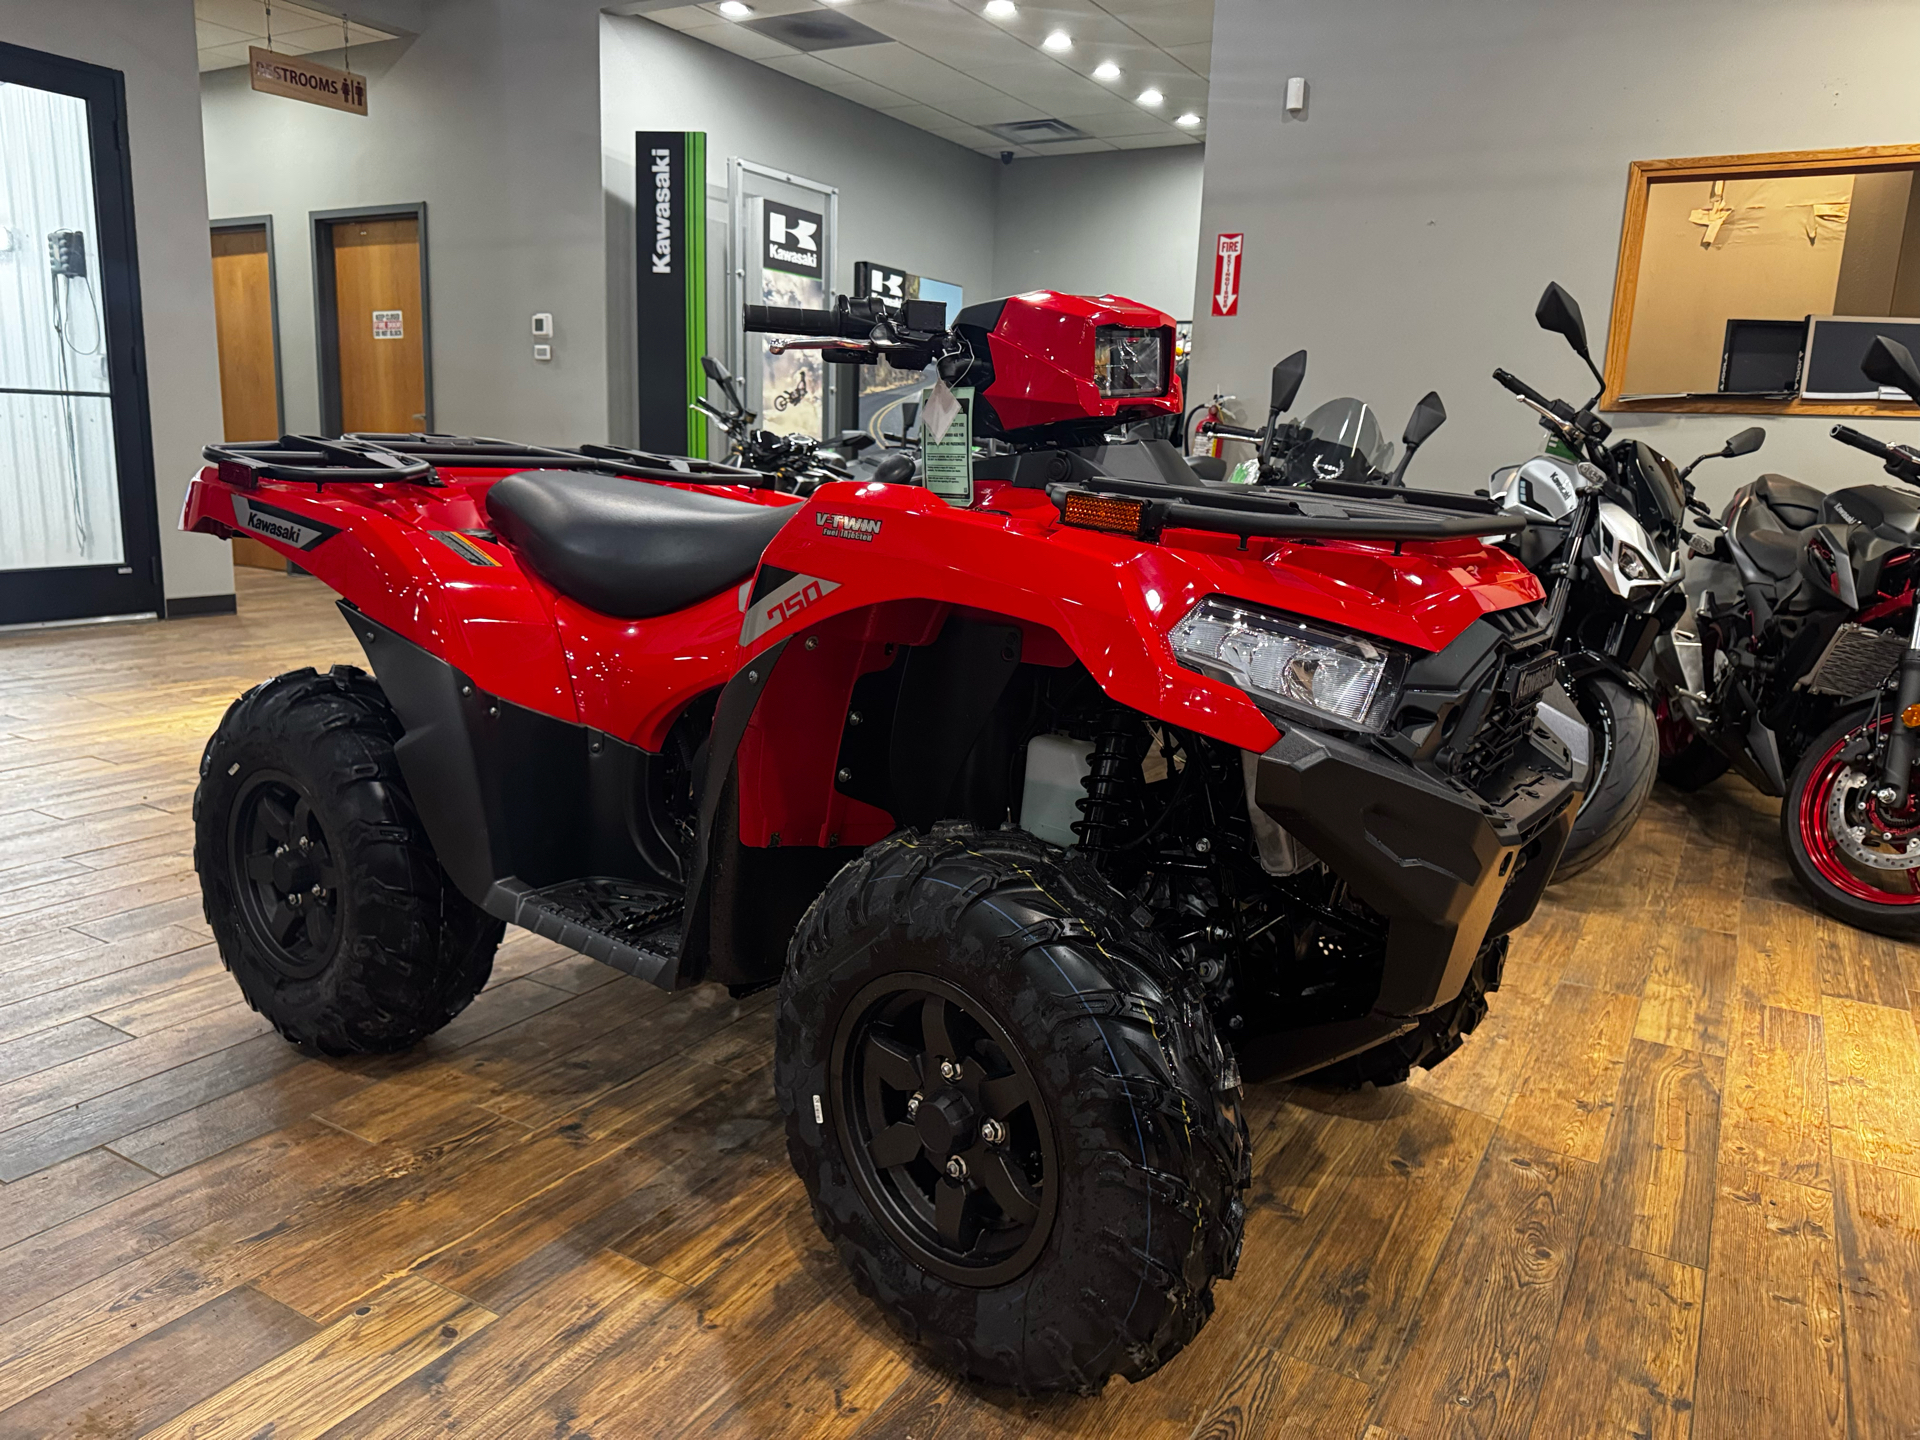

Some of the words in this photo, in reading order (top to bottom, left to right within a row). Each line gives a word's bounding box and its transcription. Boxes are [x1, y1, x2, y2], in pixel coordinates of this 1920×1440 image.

[651, 148, 671, 274] Kawasaki
[769, 243, 818, 268] Kawasaki
[1221, 241, 1239, 252] FIRE
[816, 512, 882, 534] V-TWIN
[1834, 502, 1857, 525] Kawasaki
[248, 511, 301, 543] Kawasaki
[823, 528, 838, 537] Fuel
[766, 580, 823, 622] 750
